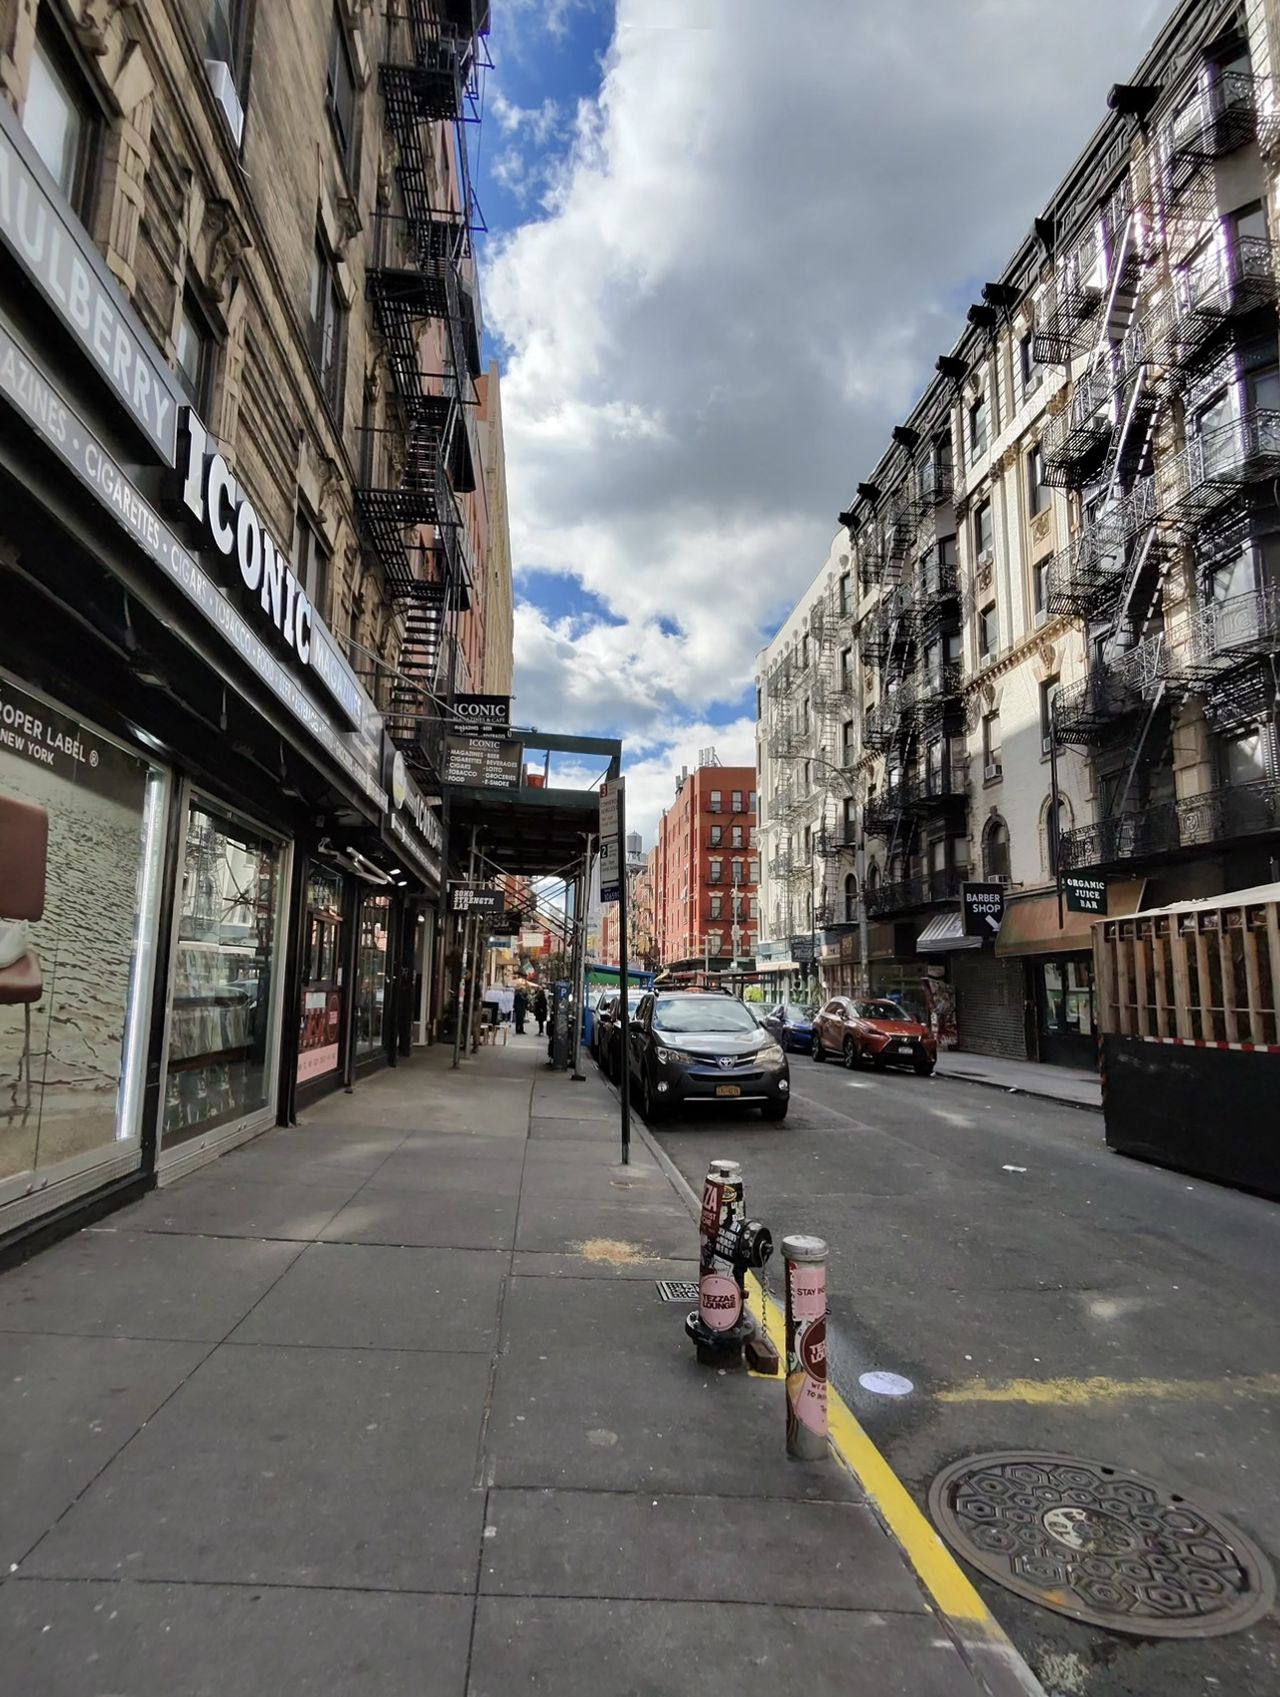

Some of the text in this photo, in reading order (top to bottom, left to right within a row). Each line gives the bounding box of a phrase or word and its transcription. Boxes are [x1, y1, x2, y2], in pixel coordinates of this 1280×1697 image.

[0, 346, 67, 442] AZINES
[84, 443, 160, 549] CIGARETTES
[170, 545, 208, 600] CIGARS
[183, 409, 312, 665] ICONIC
[453, 703, 506, 716] ICONIC
[0, 701, 43, 740] OPER
[46, 726, 86, 763] LABEL
[0, 728, 55, 765] NEW YORK
[469, 739, 500, 749] ICONIC
[451, 749, 483, 758] MAGAZINES
[449, 762, 471, 770] CIGARS
[450, 756, 518, 768] CIGARETTES BEVERAGES
[448, 769, 516, 781] TOBACCO GROCERIES
[601, 845, 607, 858] 2
[1067, 878, 1105, 889] ORGANIC
[966, 893, 1000, 902] BARBER
[1074, 890, 1100, 899] JUICE
[453, 896, 495, 905] STRENGTH
[1080, 899, 1098, 909] BAR
[972, 903, 1001, 913] SHOP
[797, 1287, 816, 1296] STAY
[702, 1293, 736, 1301] TEZZAS
[702, 1300, 736, 1310] LOUNGE
